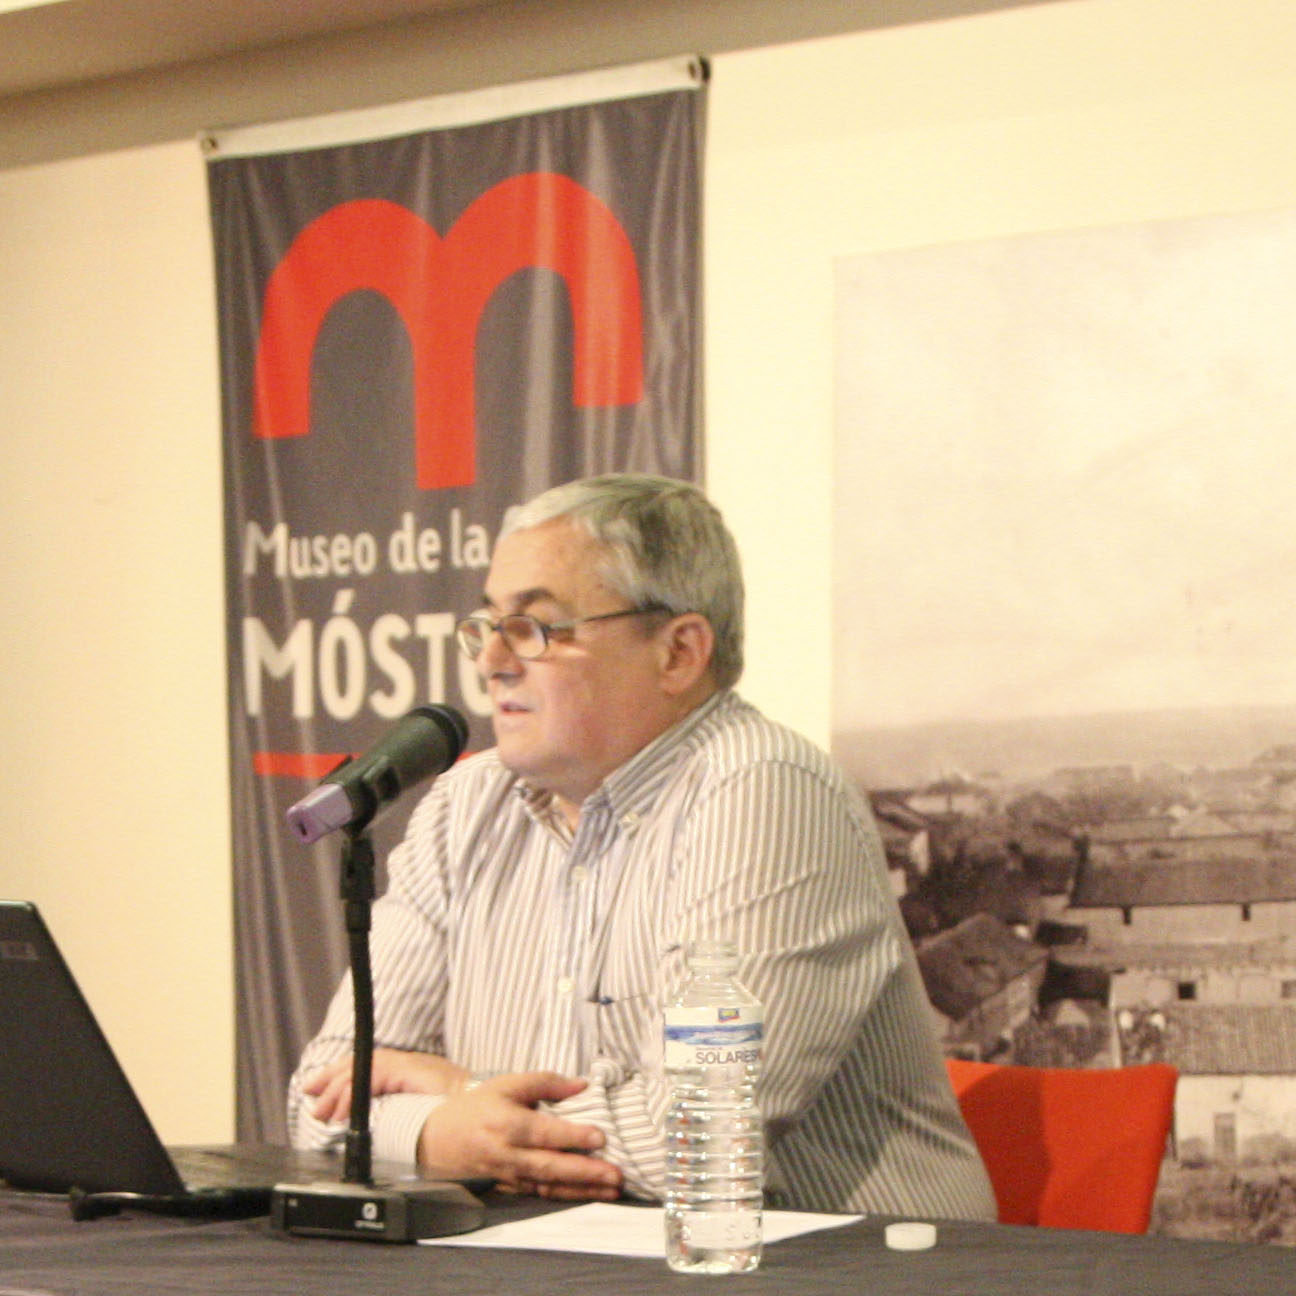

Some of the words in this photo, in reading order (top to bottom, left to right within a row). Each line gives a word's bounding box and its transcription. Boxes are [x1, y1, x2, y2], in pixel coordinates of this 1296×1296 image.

[243, 521, 377, 579] Museo
[389, 511, 442, 573] de
[451, 508, 491, 569] la
